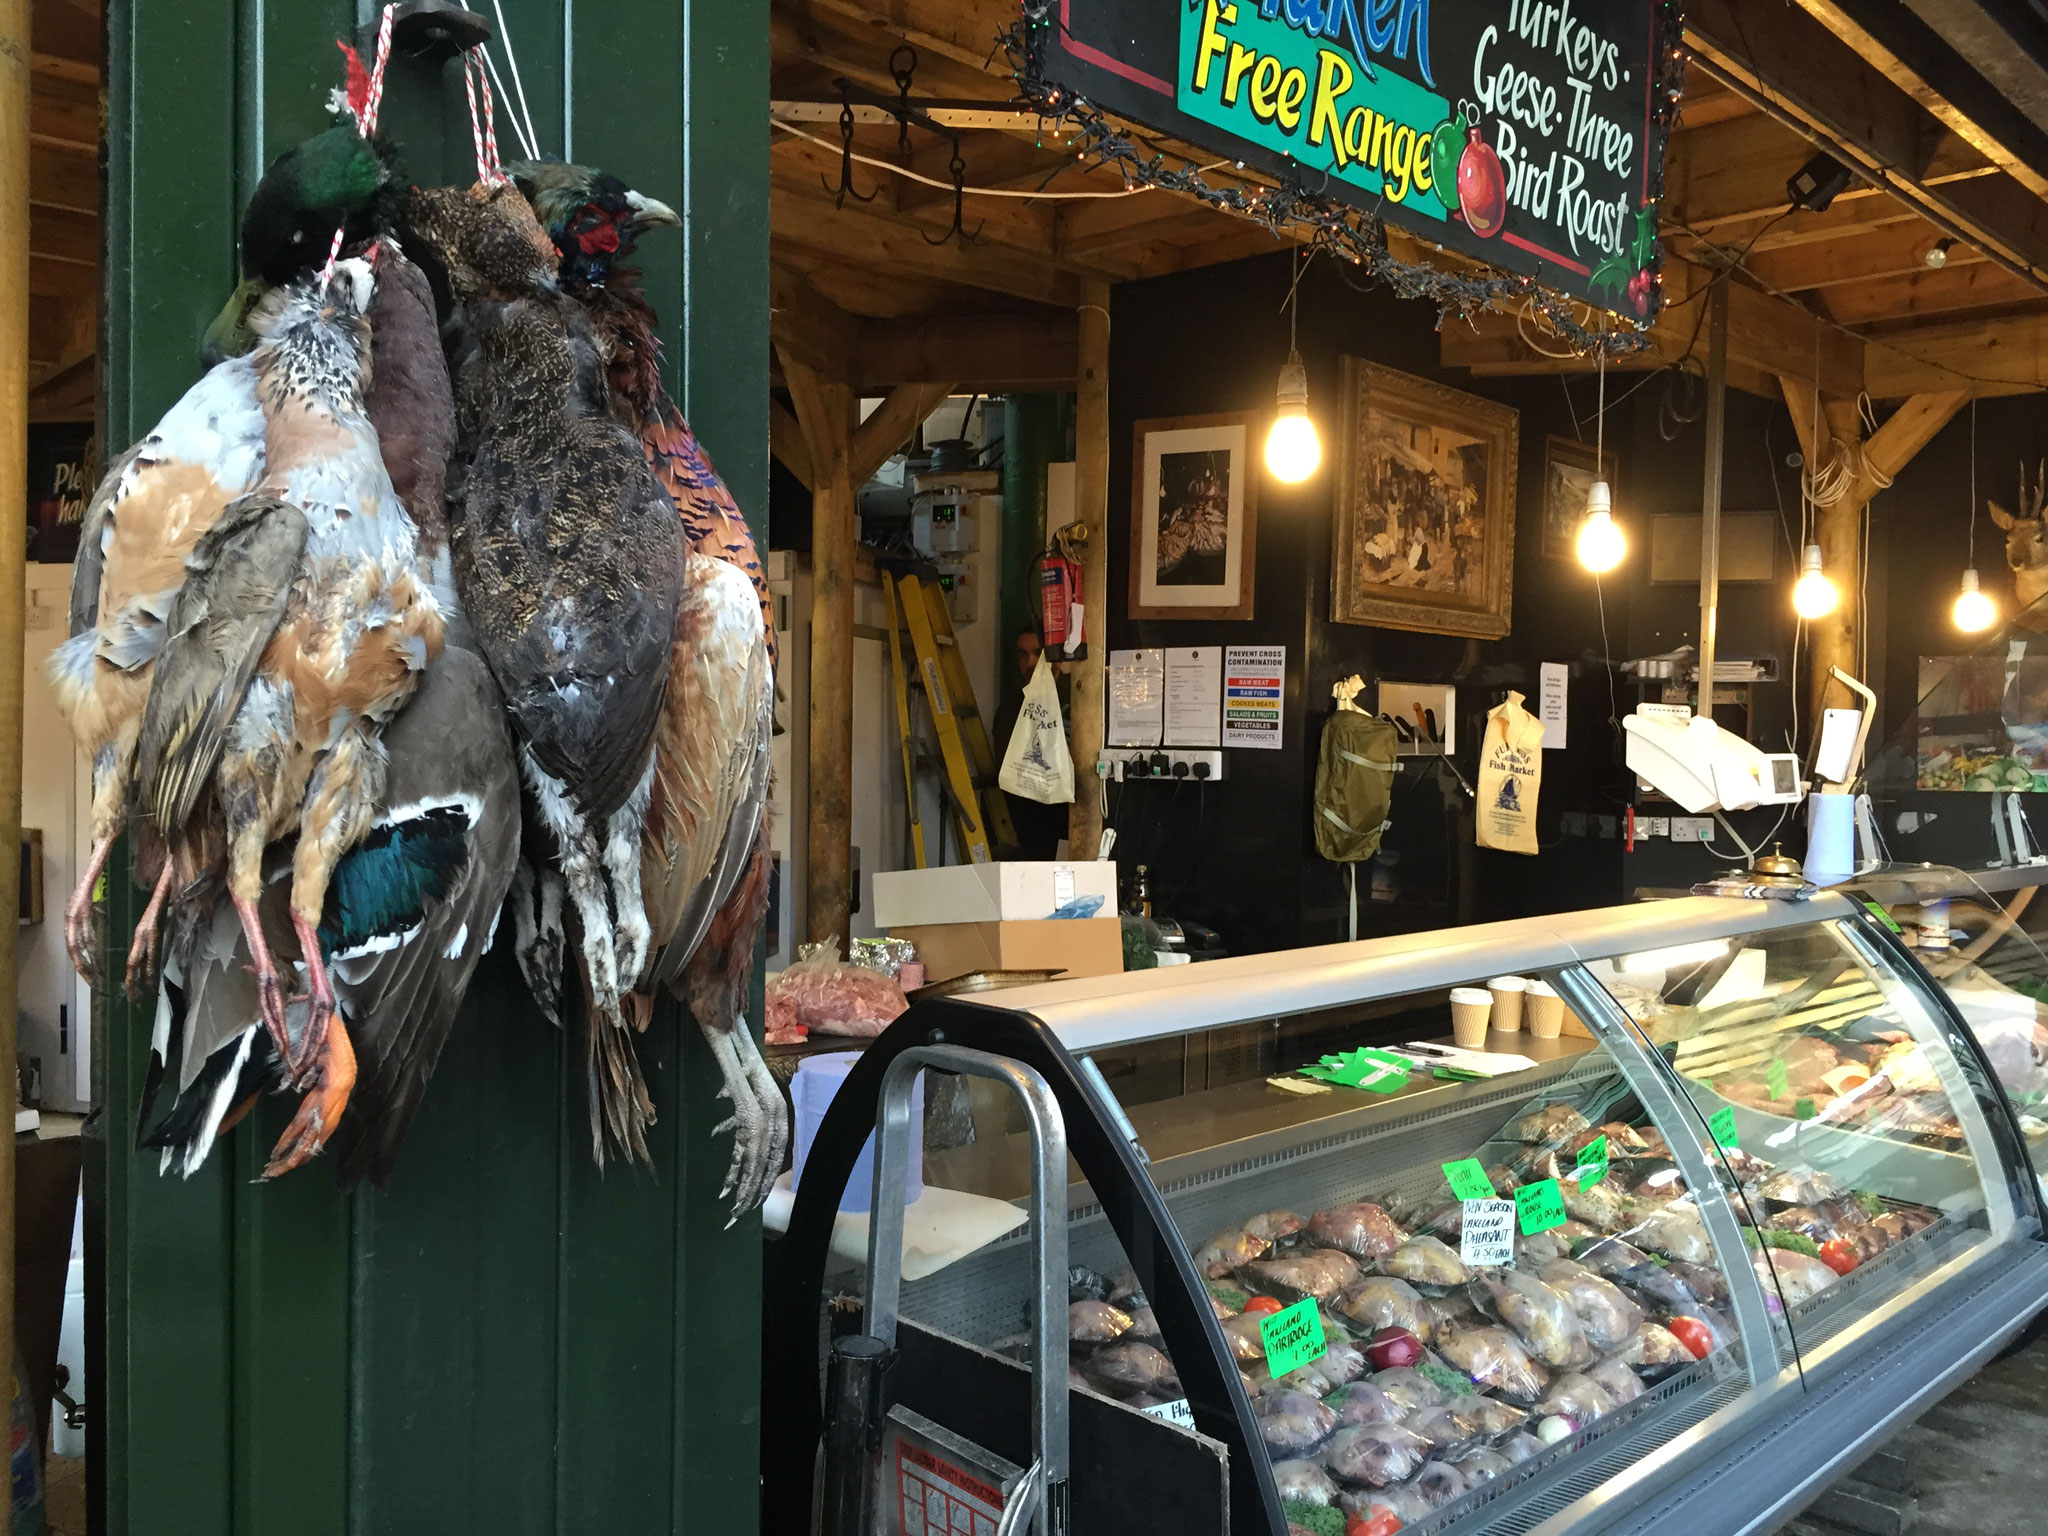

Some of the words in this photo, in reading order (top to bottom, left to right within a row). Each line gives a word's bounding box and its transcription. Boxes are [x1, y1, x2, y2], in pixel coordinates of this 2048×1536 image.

[1194, 0, 1307, 130] Free
[1310, 50, 1432, 203] Range
[1566, 76, 1633, 179] Three
[1496, 119, 1557, 220] Bird
[1557, 155, 1629, 256] Roast
[1489, 759, 1506, 771] Fish
[1509, 763, 1535, 776] Market
[1484, 1201, 1514, 1213] SEASON
[1463, 1217, 1504, 1229] LAKELAND
[1464, 1229, 1512, 1246] PHEASANT
[1267, 1311, 1302, 1342] LAKELAND
[1268, 1319, 1312, 1357] PARTRIDGE
